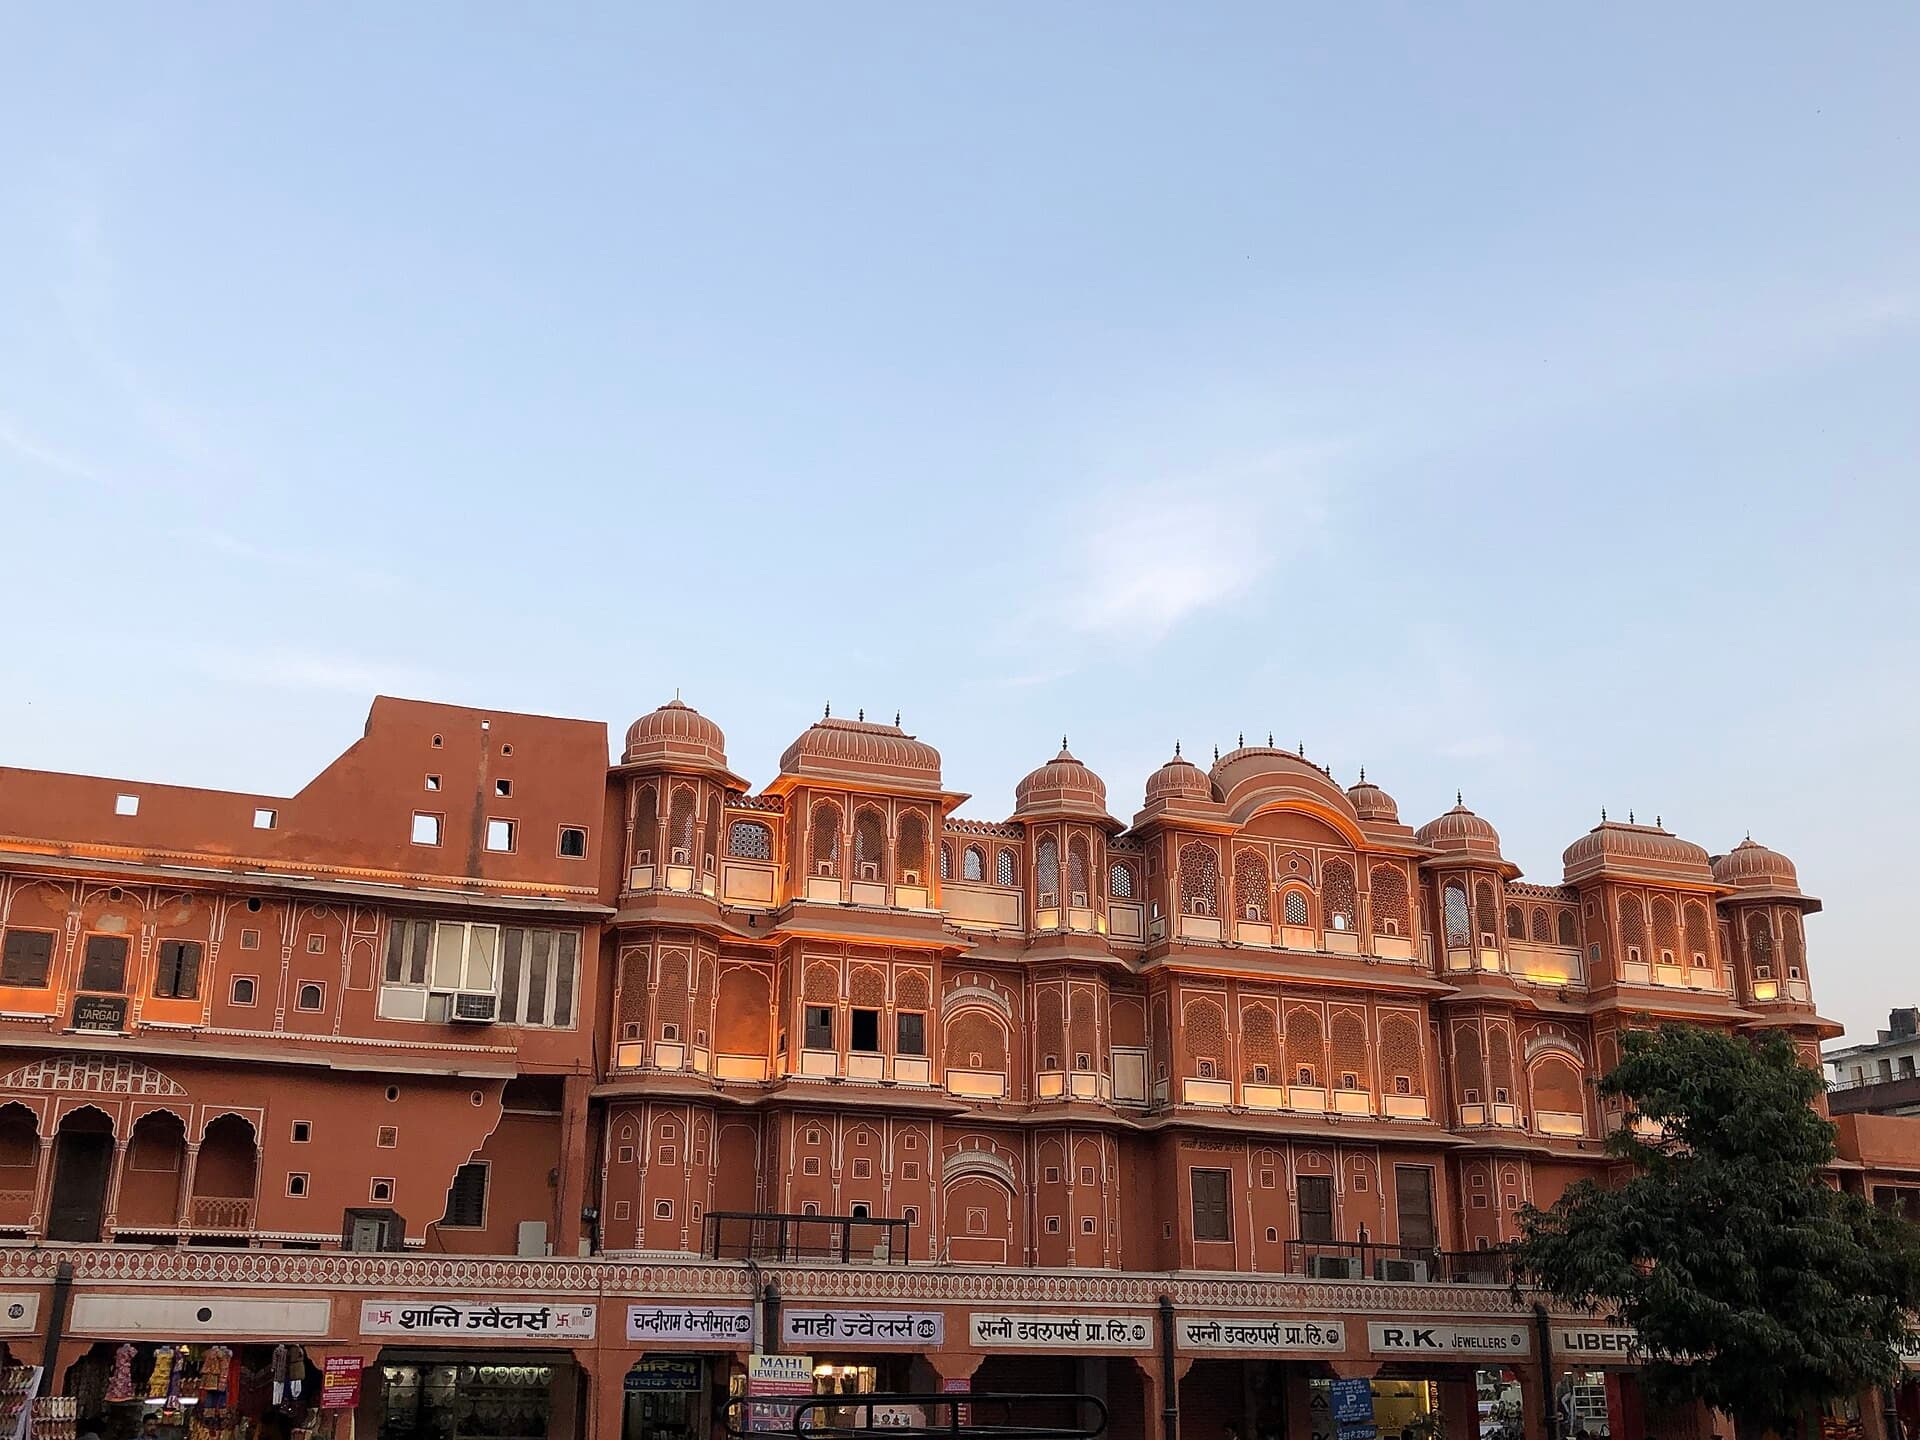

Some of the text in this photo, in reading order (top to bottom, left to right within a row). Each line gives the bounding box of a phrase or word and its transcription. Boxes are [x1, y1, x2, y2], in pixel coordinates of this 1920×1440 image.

[79, 1008, 120, 1021] JARGAD
[399, 1305, 462, 1329] शान्ति
[466, 1307, 551, 1331] ज्वैलर्स
[633, 1310, 682, 1333] चन्दीराम
[735, 1319, 749, 1330] 288
[791, 1313, 935, 1338] माही ज्वैलर्स 289
[977, 1317, 1013, 1340] सन्नी
[1017, 1318, 1081, 1341] डवलपर्स
[1187, 1321, 1222, 1344] सन्नी
[1224, 1322, 1280, 1345] डवलपर्स
[1383, 1329, 1443, 1348] R.K.
[1451, 1333, 1507, 1349] JEWELLERS
[1564, 1333, 1639, 1352] LIBER
[760, 1357, 803, 1369] MAHI
[752, 1369, 810, 1380] JEWELLERS
